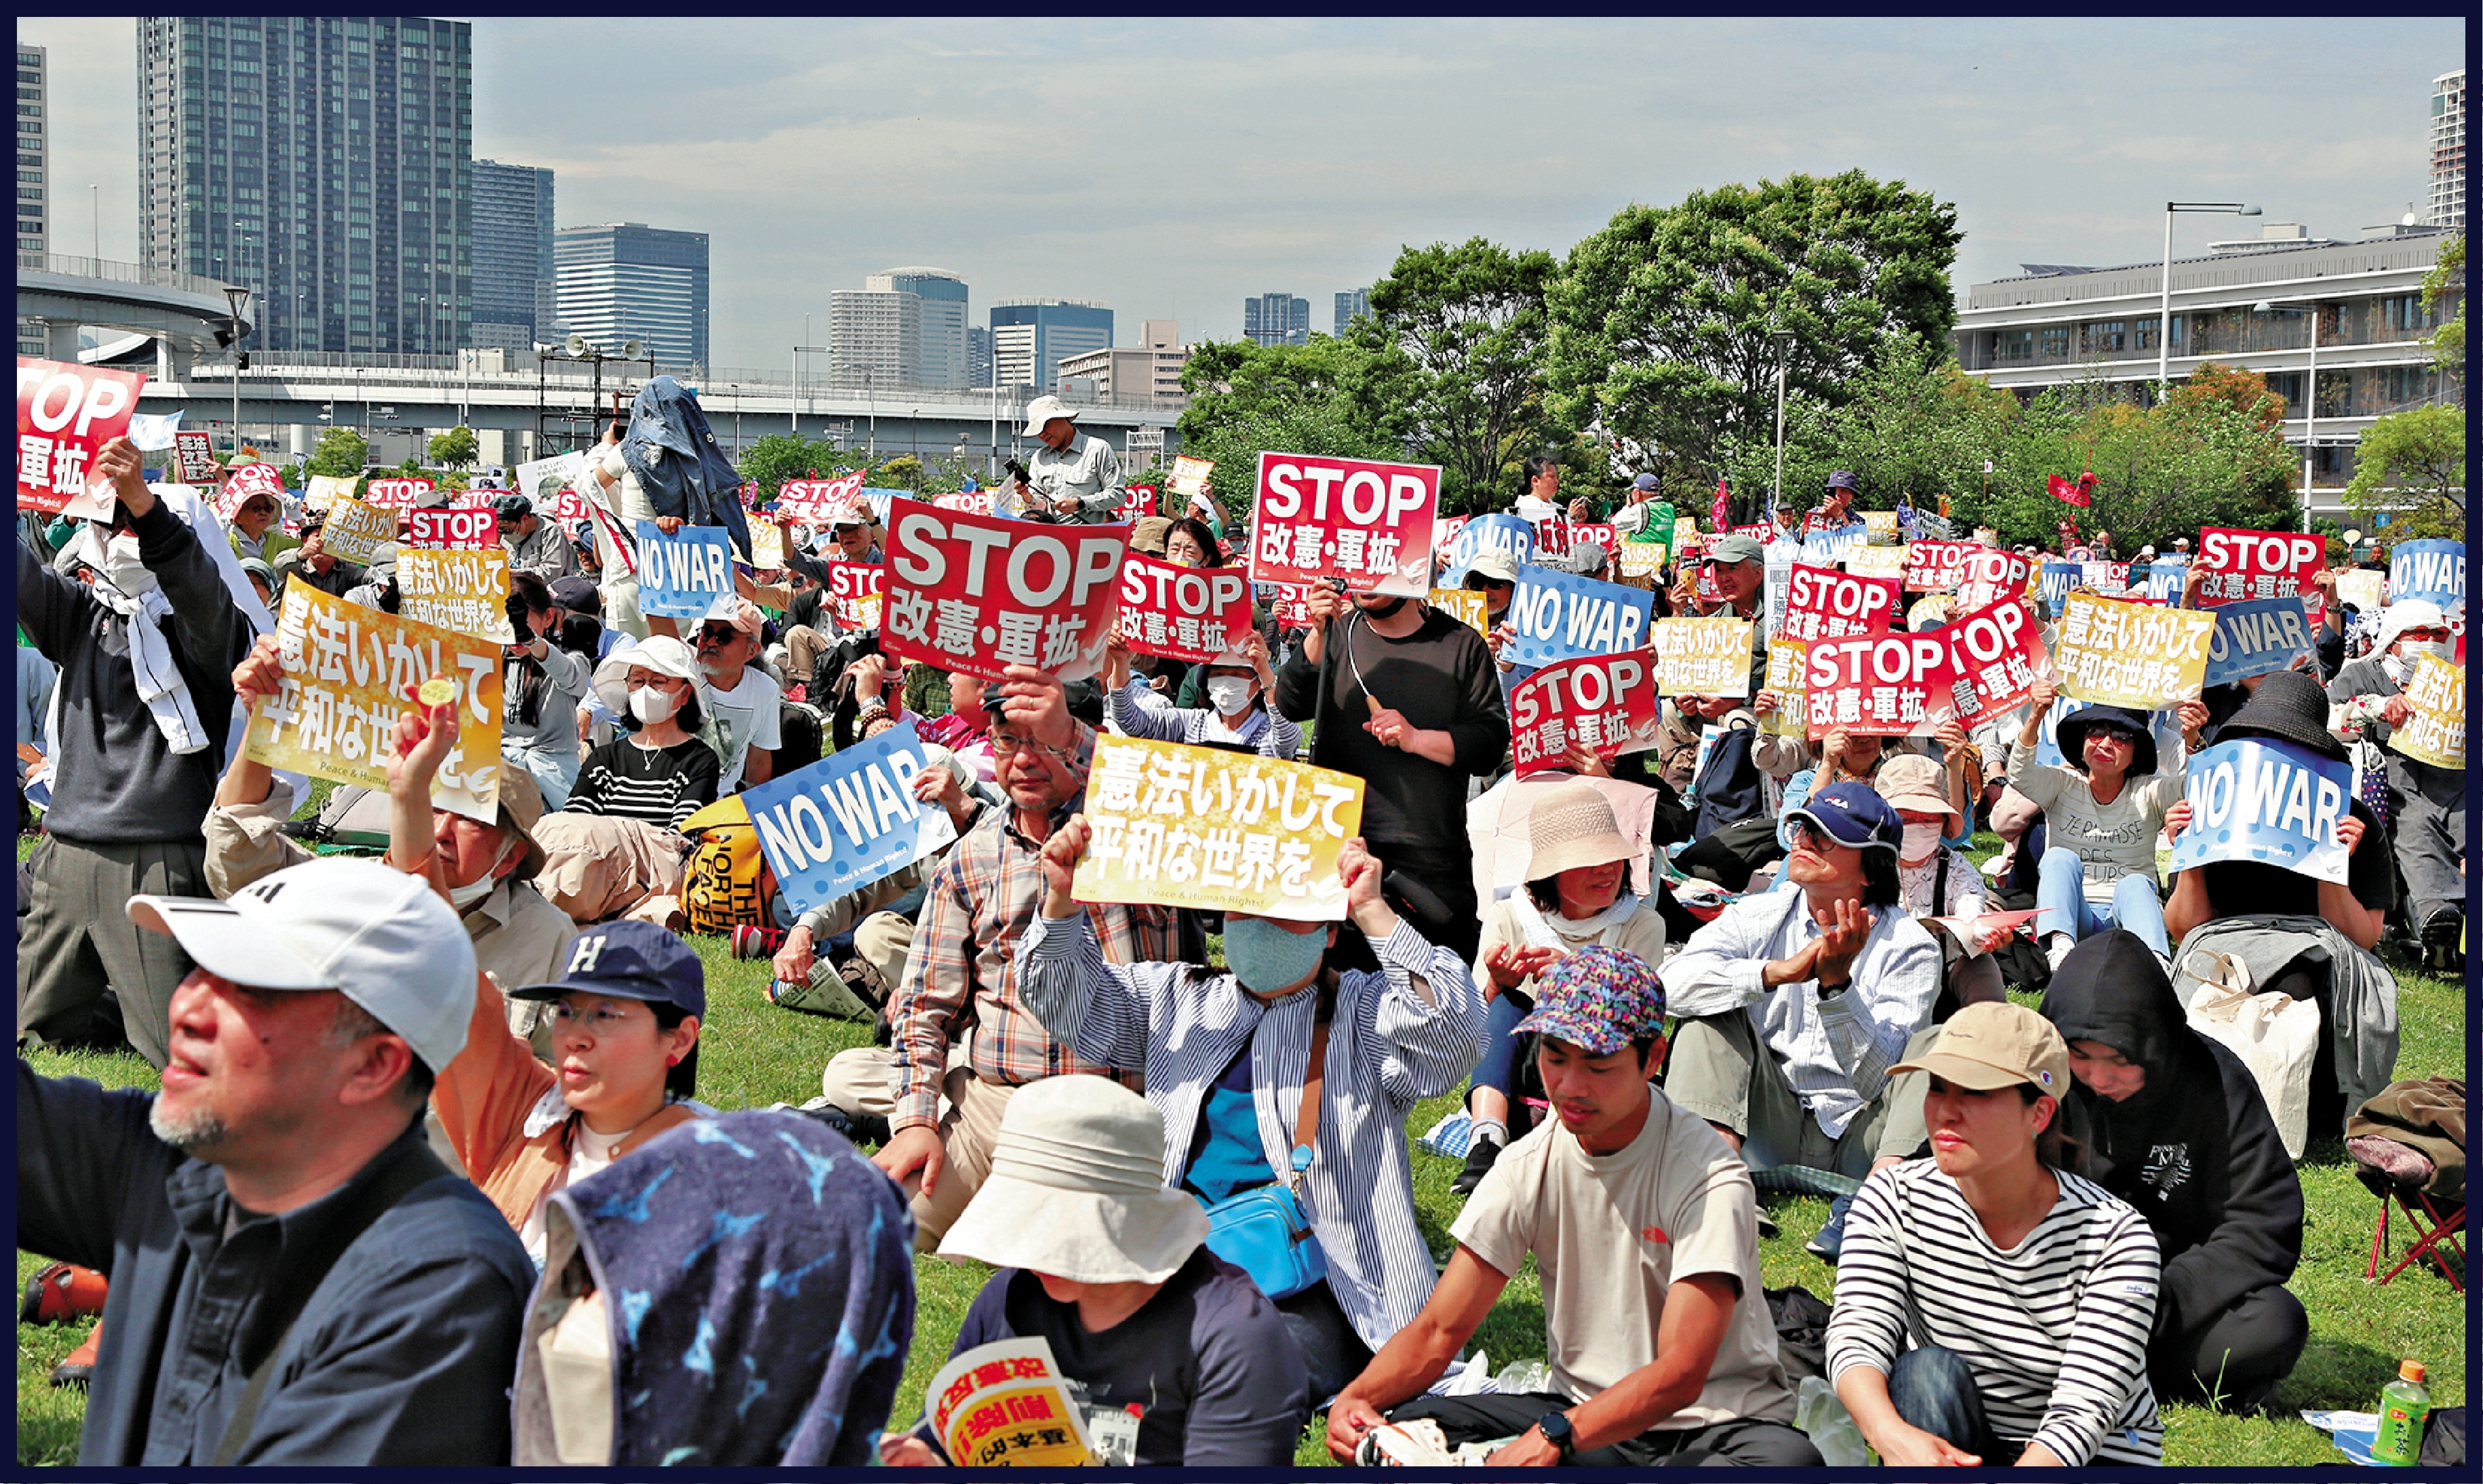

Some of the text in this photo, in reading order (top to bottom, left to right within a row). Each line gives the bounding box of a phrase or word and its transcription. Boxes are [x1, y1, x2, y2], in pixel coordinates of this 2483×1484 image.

[461, 491, 505, 509] STO
[787, 473, 861, 503] STOP
[1265, 463, 1427, 527] STOP
[412, 512, 492, 539] STOP
[1260, 522, 1401, 576] 改憲・軍拡
[1477, 526, 1528, 564] WAR
[1535, 515, 1571, 558] 反対
[398, 555, 504, 595] 憲法いかして
[638, 538, 731, 593] NO WAR
[893, 513, 1124, 608] STOP
[1910, 543, 1976, 568] STO
[2204, 532, 2317, 573] STOP
[2389, 553, 2411, 599] NO
[1121, 560, 1243, 616] STOP
[1791, 569, 1888, 619] STOP
[2201, 571, 2301, 600] 改憲・軍拡
[888, 586, 1087, 671] 改憲・軍拡
[1121, 606, 1229, 653] 改憲・軍拡
[1512, 582, 1642, 655] NO WAR
[1653, 622, 1750, 656] 憲法いかして
[2062, 600, 2210, 661] 憲法いかして
[2227, 610, 2309, 655] WAR
[946, 657, 971, 672] Peace
[974, 665, 982, 673] &
[1652, 658, 1735, 686] 平和な世界を
[1809, 639, 1944, 688] STOP
[1951, 650, 2036, 720] 憲・軍拡
[2056, 645, 2181, 700] 平和な世界を
[1515, 659, 1642, 728] STOP
[1809, 686, 1927, 726] 改憲・軍拡
[1516, 709, 1632, 764] 改憲・軍拡
[320, 761, 349, 778] Peace
[351, 768, 358, 779] &
[1093, 744, 1355, 839] 憲法いかして
[2182, 760, 2341, 848] NO WAR
[754, 794, 833, 878] NO
[1089, 814, 1312, 897] 平和な世界を
[2079, 848, 2114, 863] DES
[712, 834, 735, 926] NORTH
[733, 877, 758, 926] THE
[1147, 887, 1265, 908] Peace & Human Rights!
[569, 935, 607, 973] H
